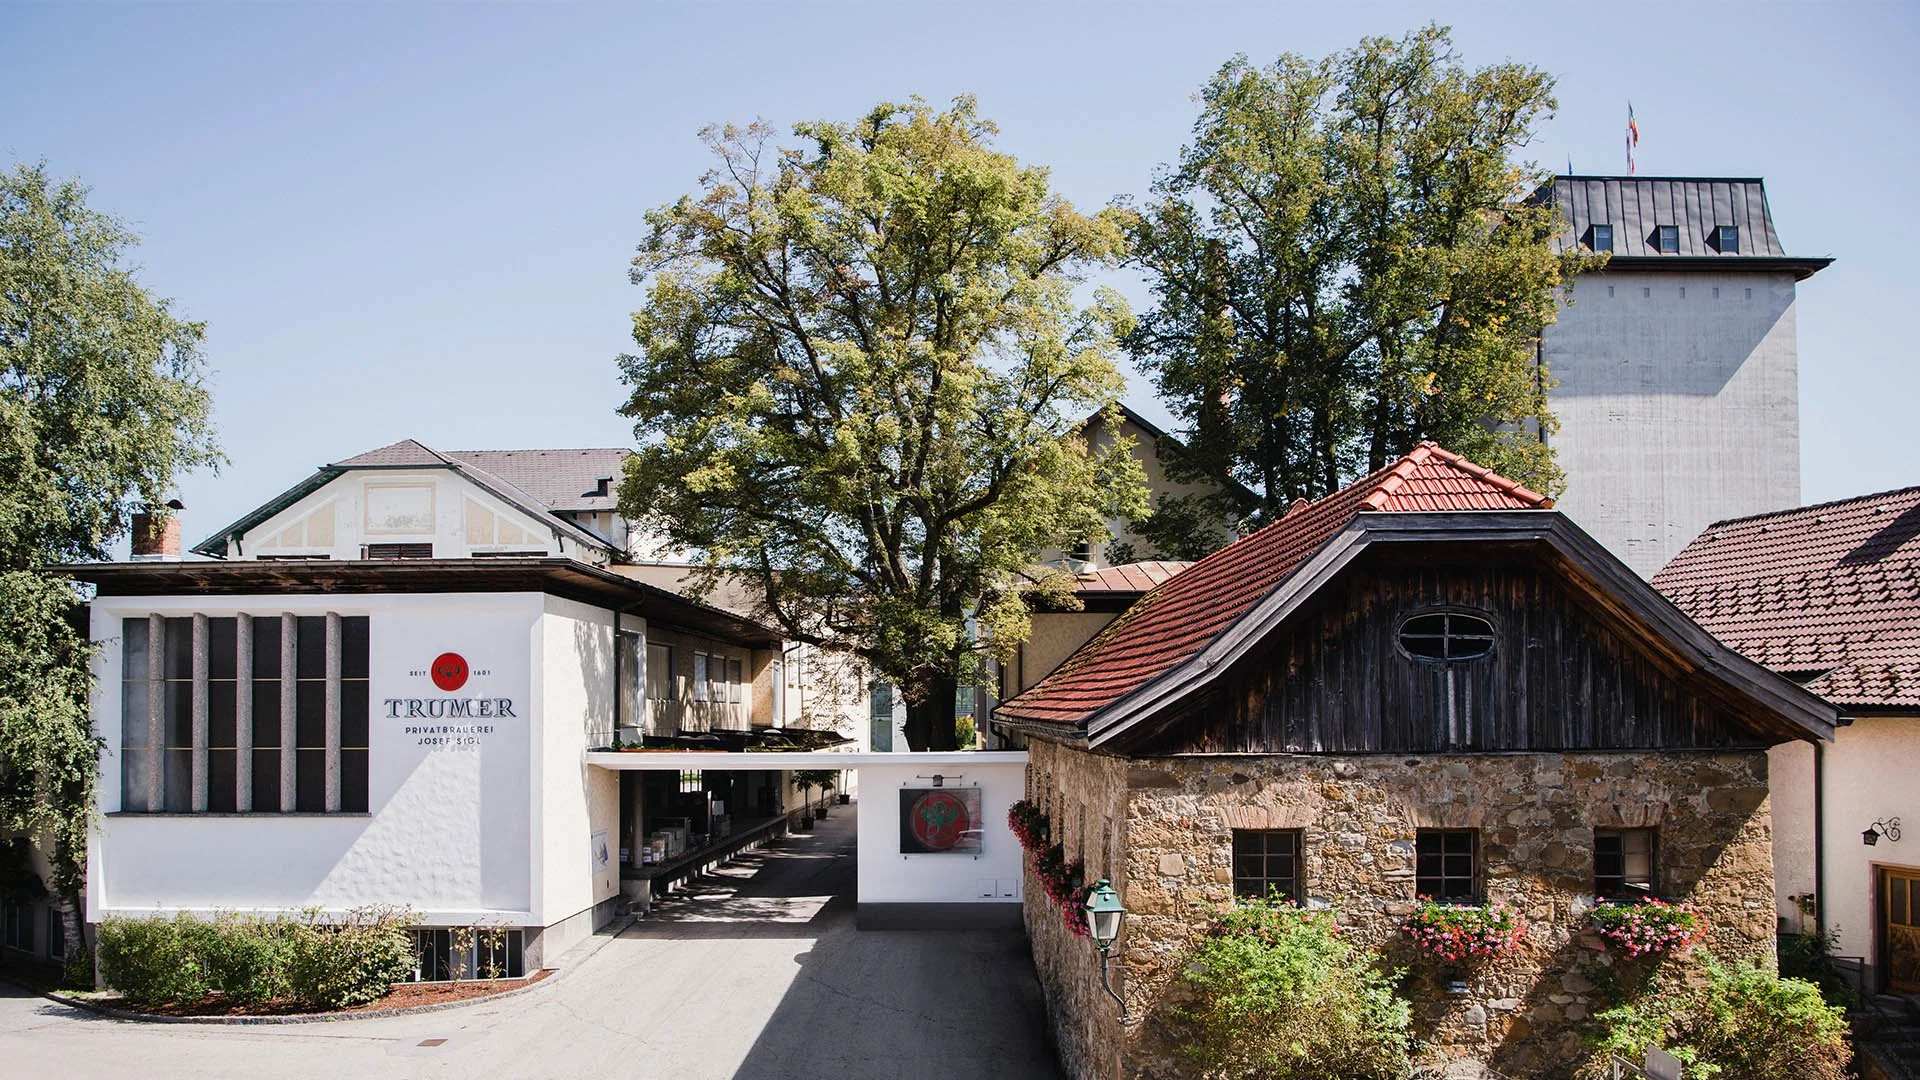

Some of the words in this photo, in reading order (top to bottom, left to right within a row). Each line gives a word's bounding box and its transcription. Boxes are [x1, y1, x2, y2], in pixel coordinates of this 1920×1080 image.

[384, 698, 518, 719] TRUMER
[405, 725, 494, 734] PRIVATBRAUEREI
[418, 737, 451, 745] JOSEF
[456, 736, 481, 745] SIGL
